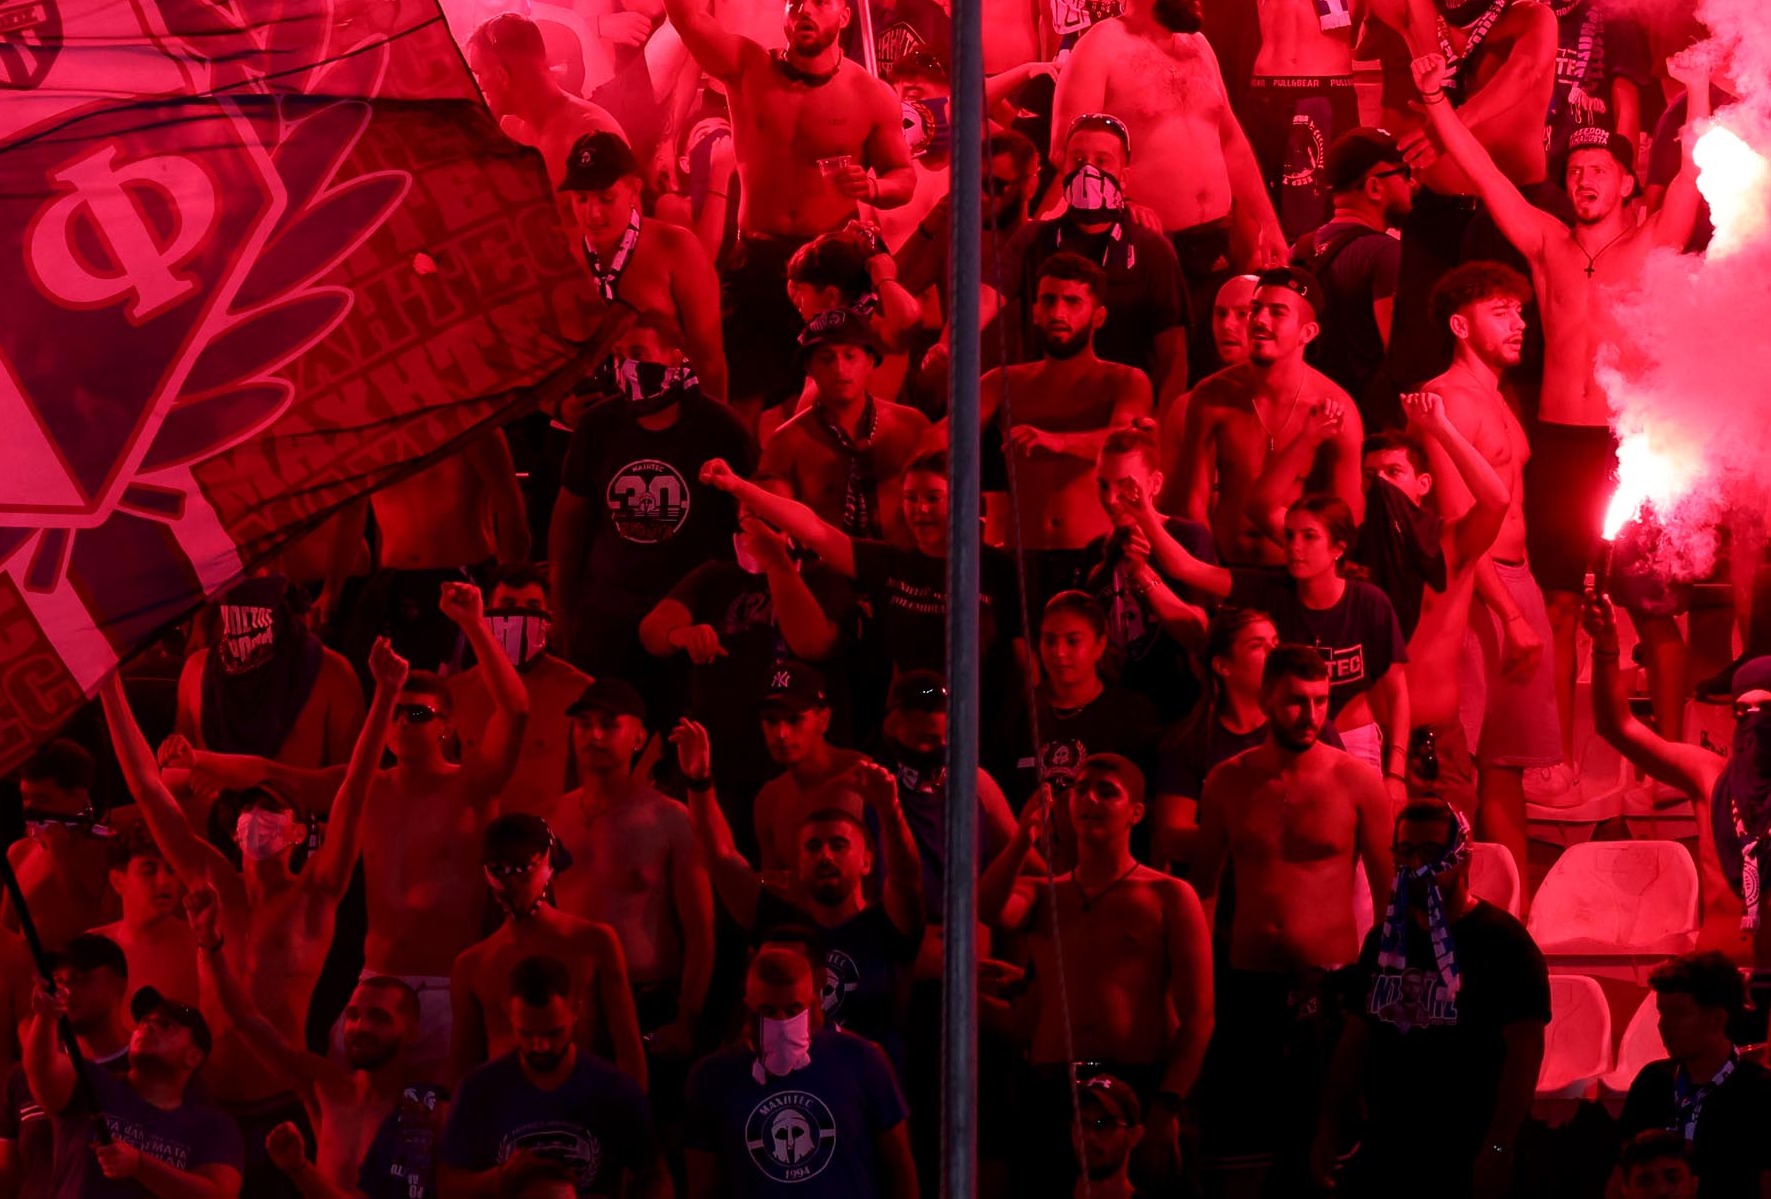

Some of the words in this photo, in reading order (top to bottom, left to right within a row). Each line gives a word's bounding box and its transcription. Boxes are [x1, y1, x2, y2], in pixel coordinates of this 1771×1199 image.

[28, 143, 225, 328] Φ
[614, 475, 682, 518] 30
[784, 1163, 812, 1182] 1994
